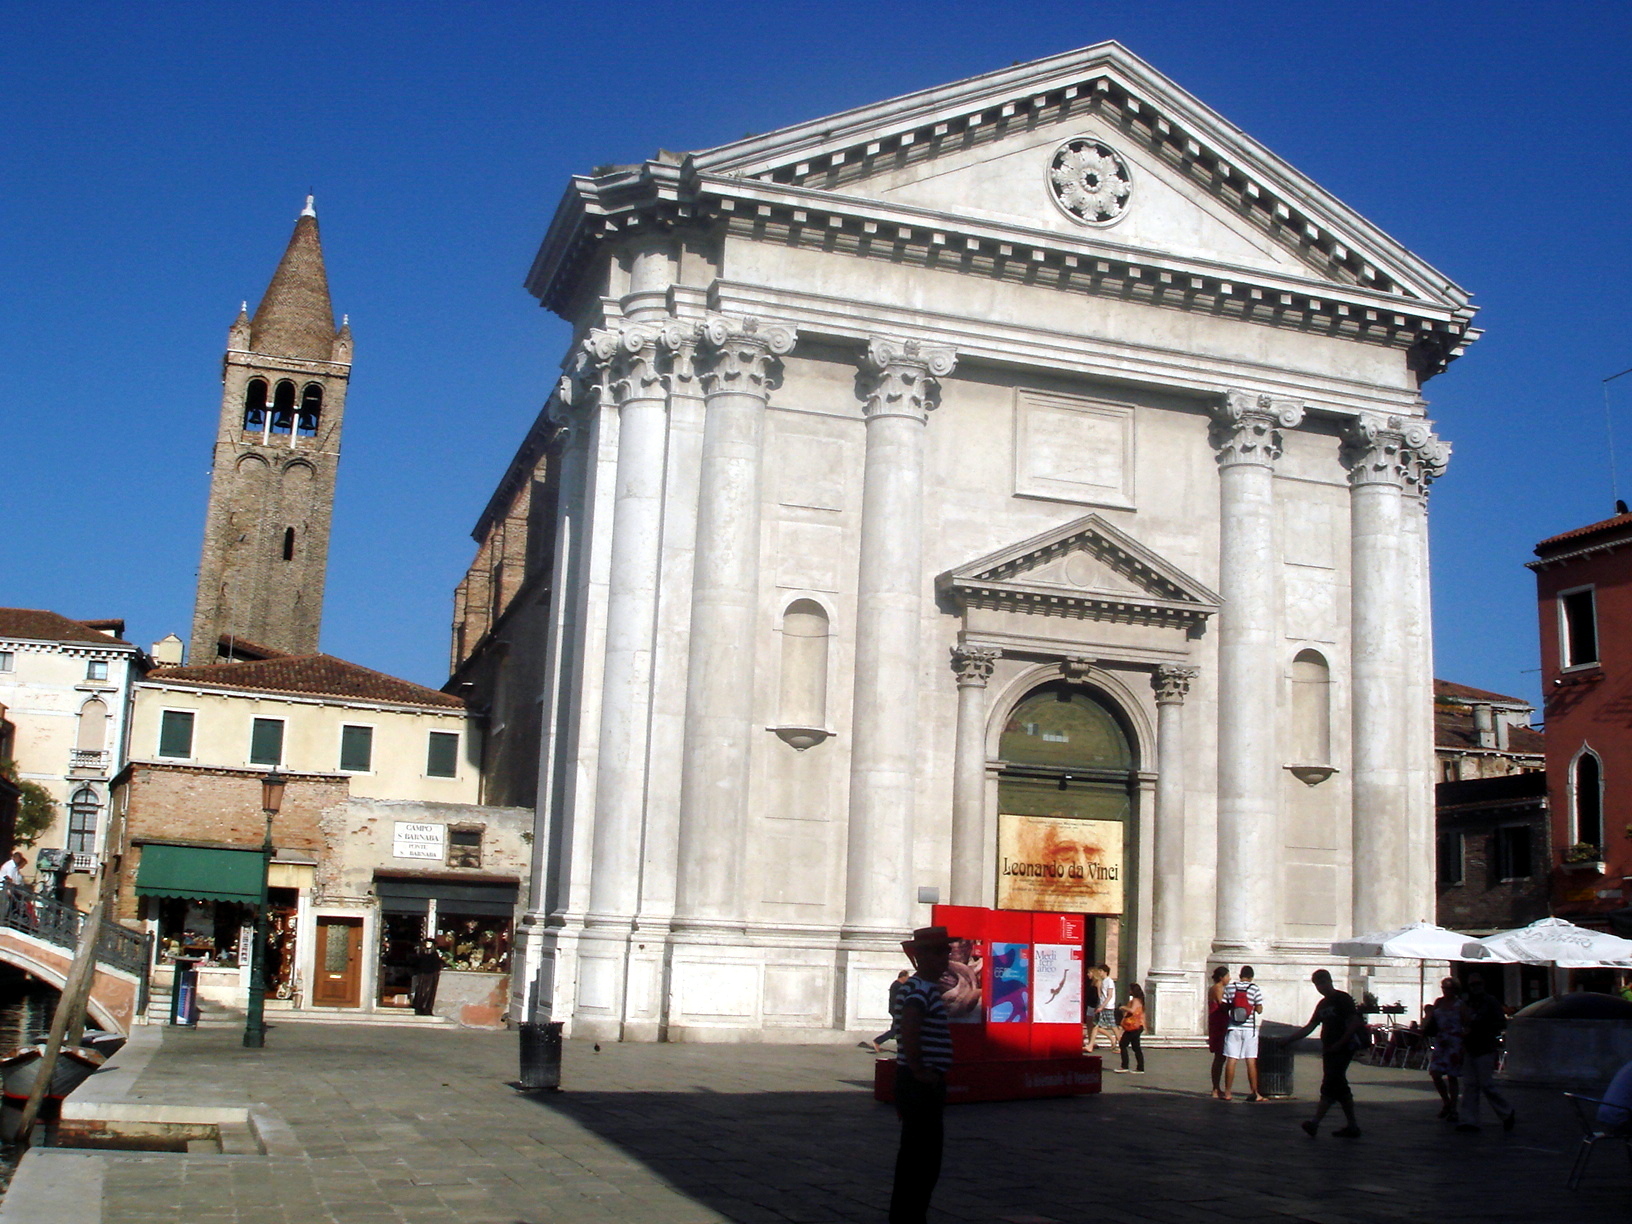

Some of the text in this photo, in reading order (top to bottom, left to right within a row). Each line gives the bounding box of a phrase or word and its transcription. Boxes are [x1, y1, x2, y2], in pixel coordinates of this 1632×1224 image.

[404, 833, 439, 841] BARNABA
[1003, 857, 1119, 881] Leonardo da Vinci
[1035, 949, 1057, 961] Medi
